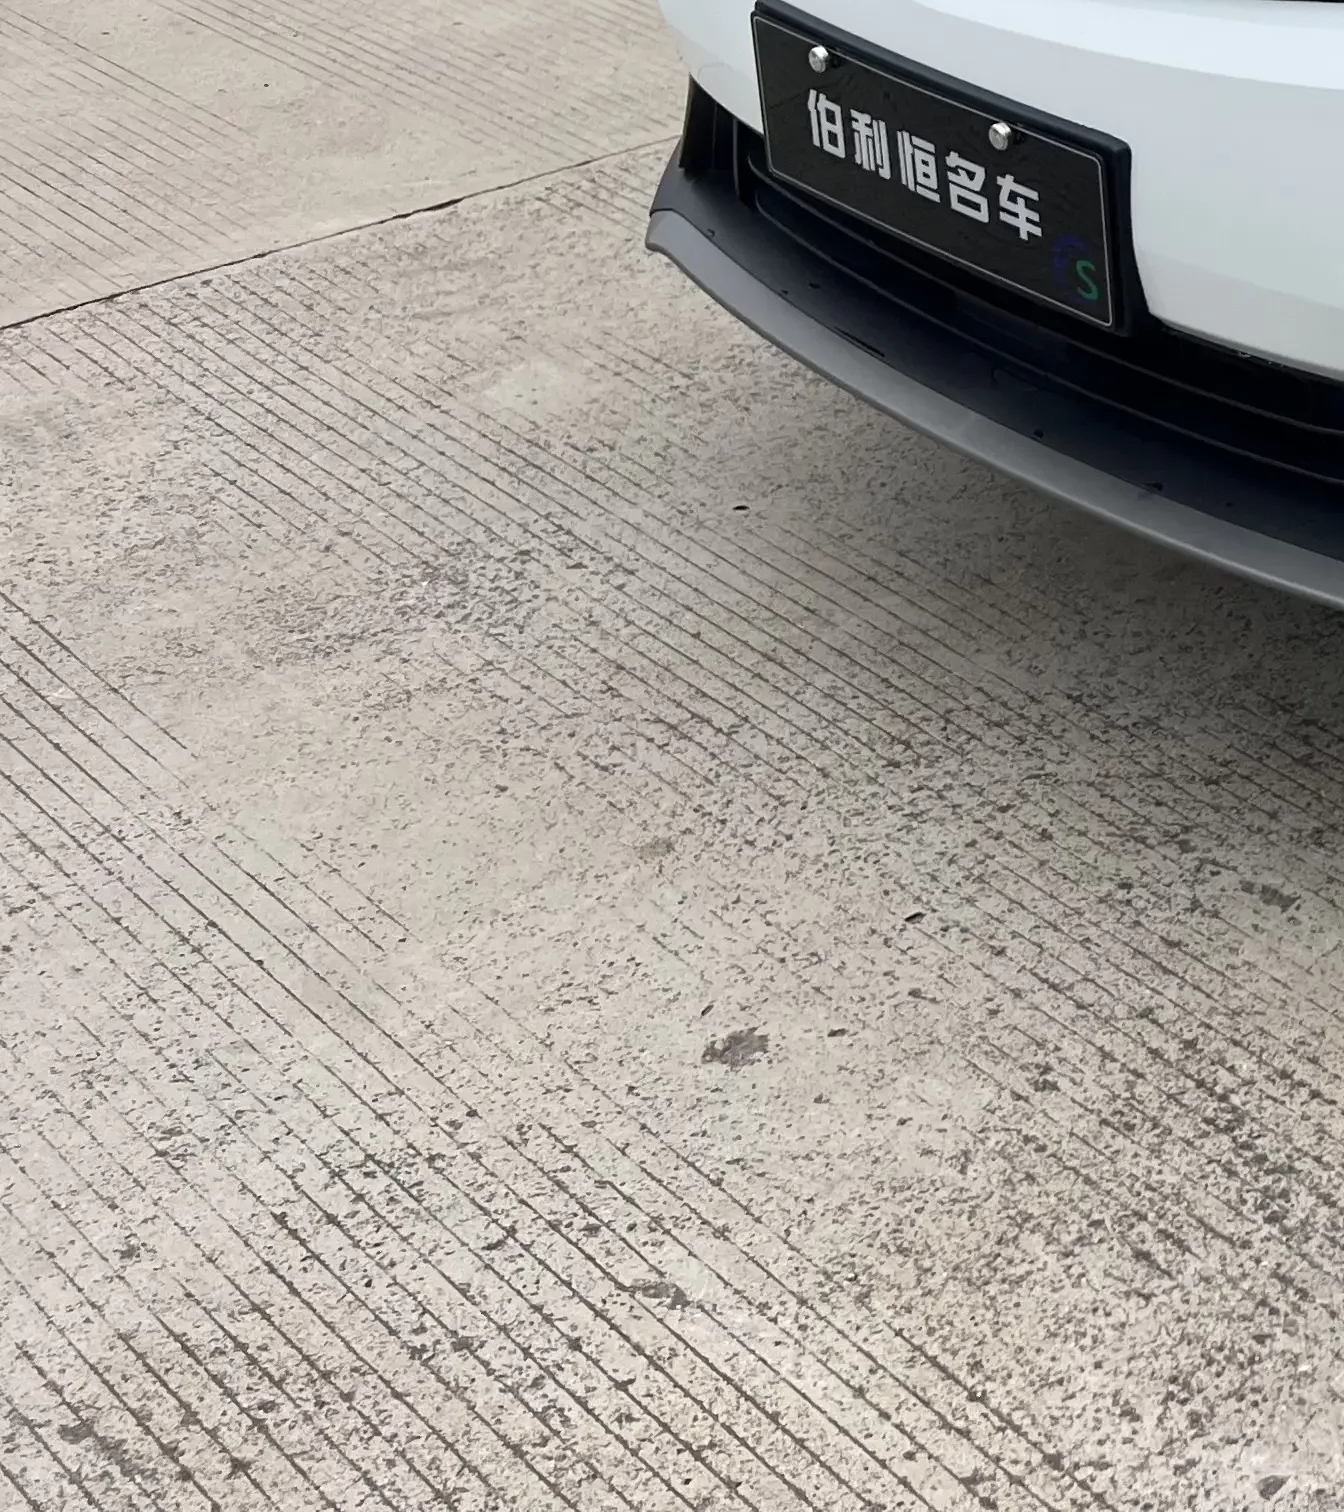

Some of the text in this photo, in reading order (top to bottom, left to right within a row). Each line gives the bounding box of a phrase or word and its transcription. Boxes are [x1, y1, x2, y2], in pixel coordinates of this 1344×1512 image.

[807, 89, 1043, 241] 伯利恒名车
